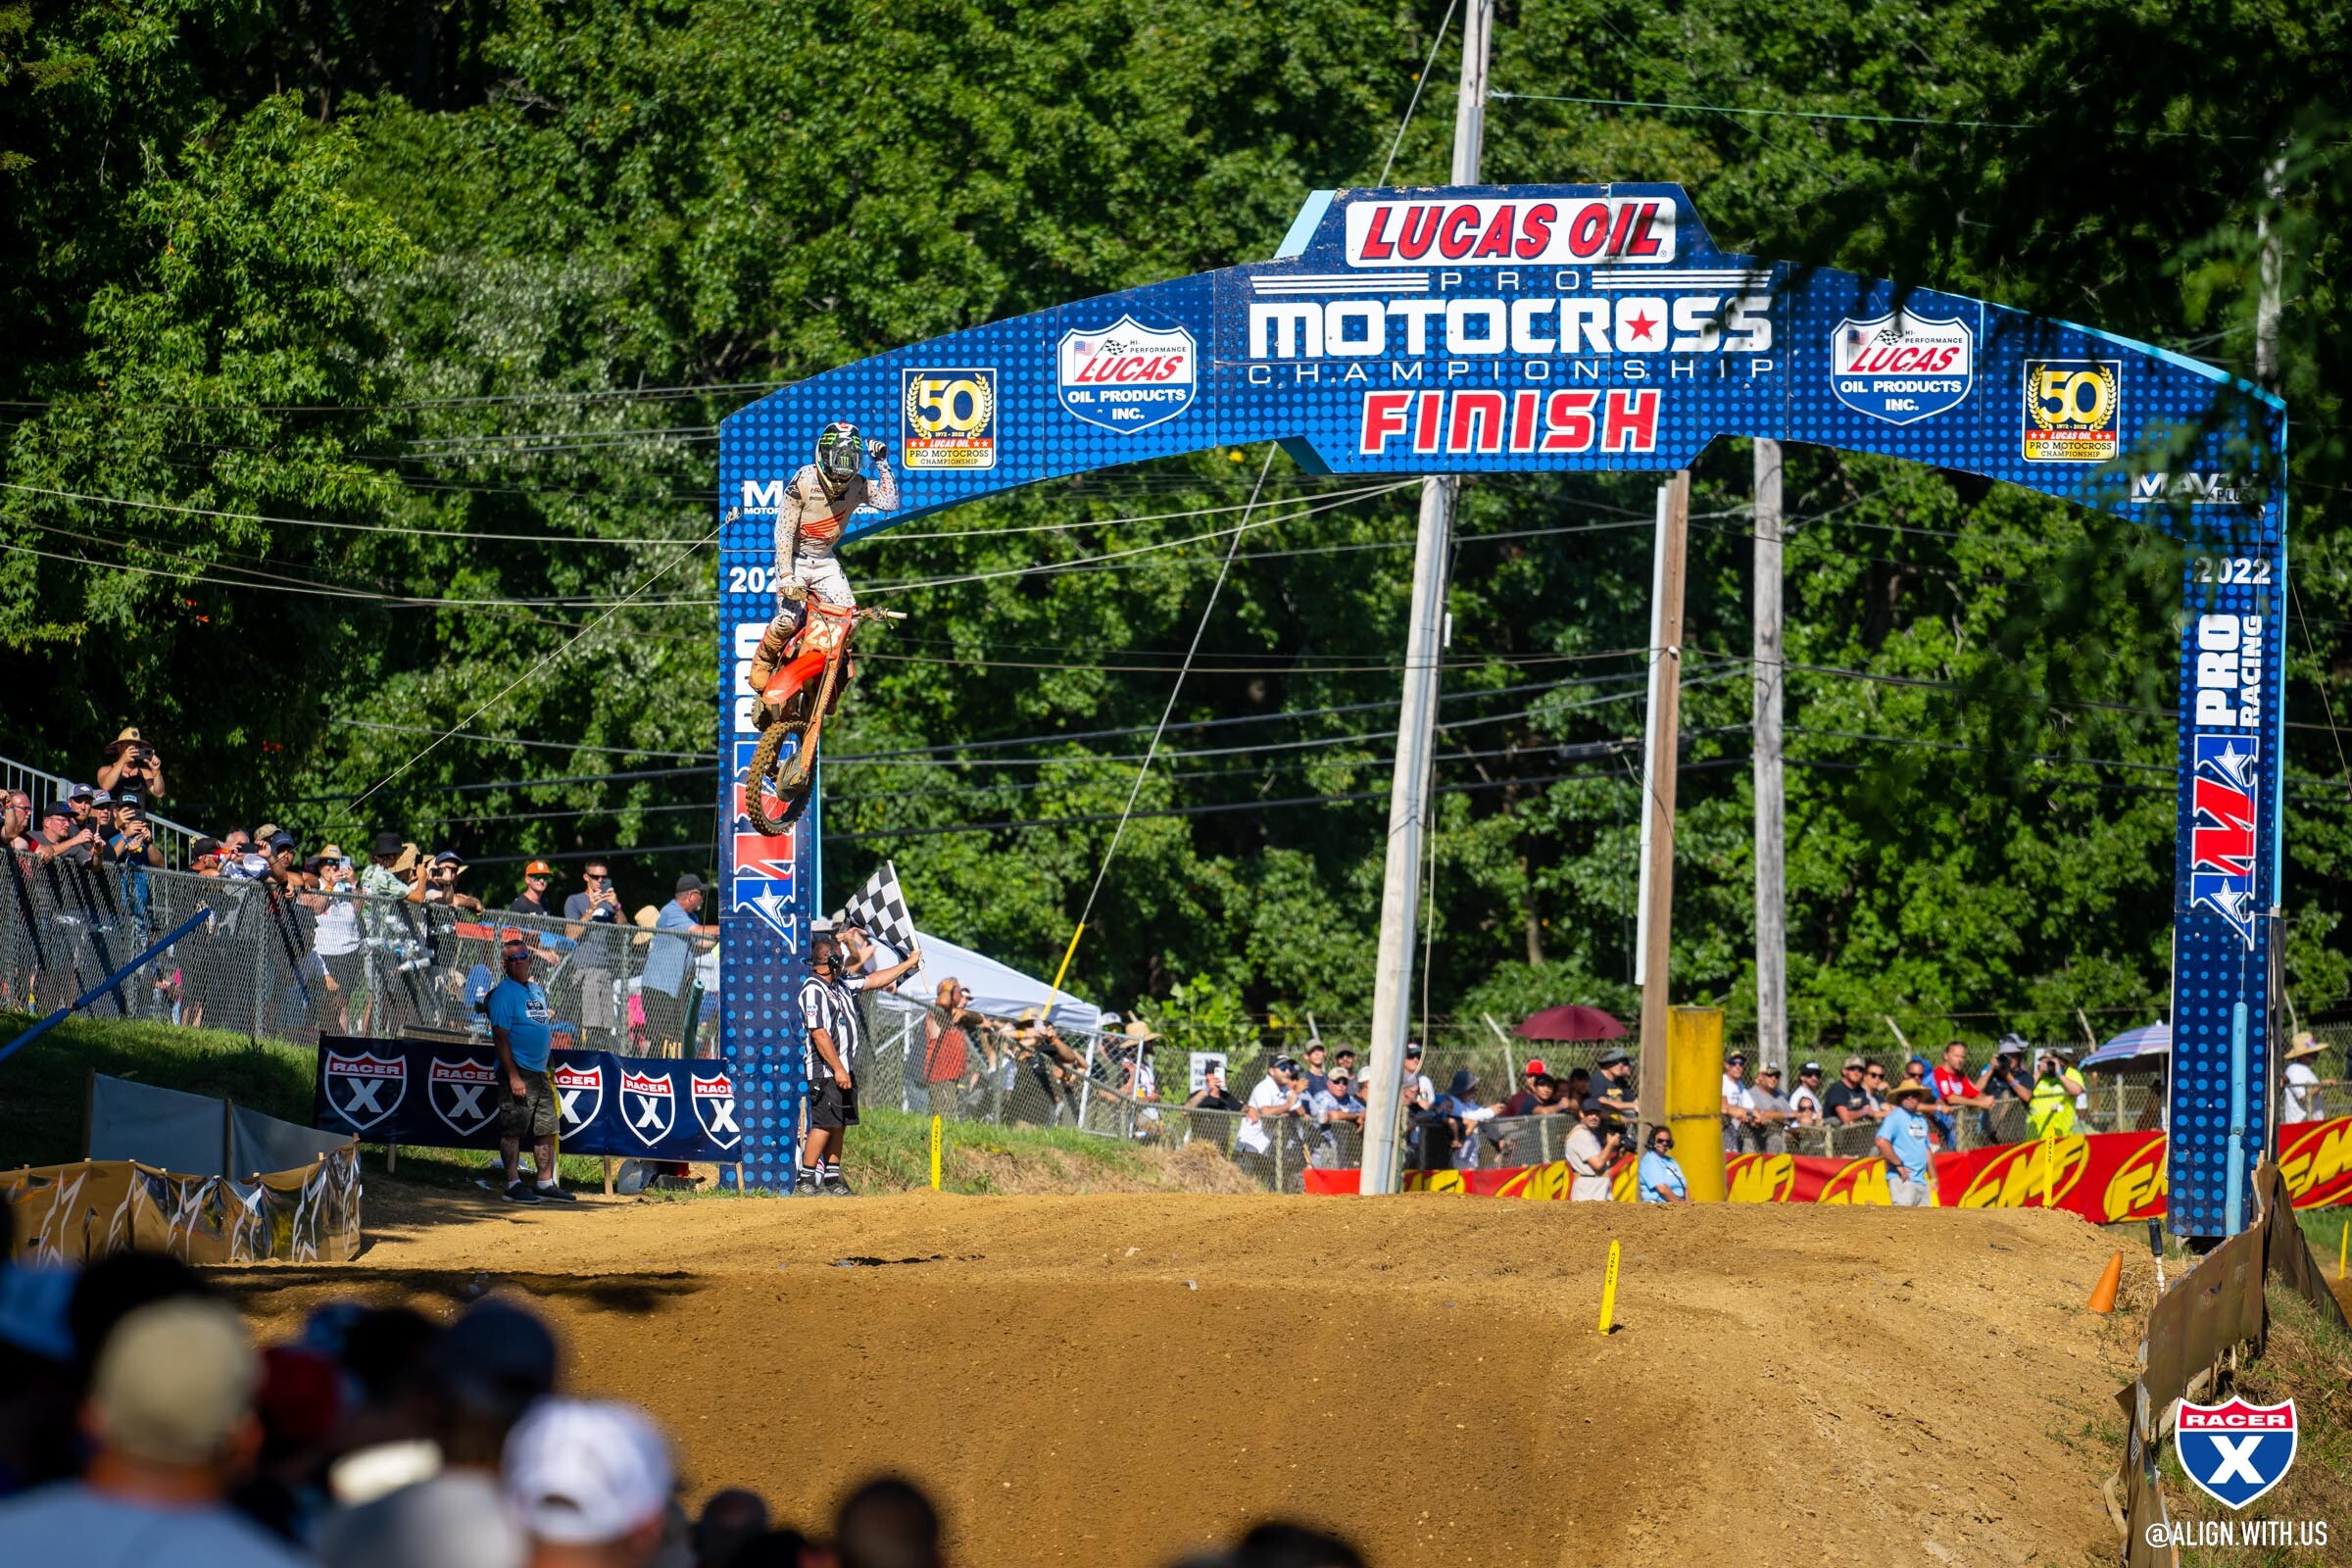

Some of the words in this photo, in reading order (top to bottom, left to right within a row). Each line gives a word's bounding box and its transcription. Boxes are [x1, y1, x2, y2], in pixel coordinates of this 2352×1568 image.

[1360, 204, 1557, 261] LUCAS
[1568, 202, 1663, 257] OIL
[1441, 271, 1580, 291] PRO
[1250, 297, 1773, 359] MOTOCROSS
[1074, 356, 1184, 383] LUCAS
[1249, 360, 1774, 385] CHAMPIONSHIP
[1848, 347, 1960, 372] LUCAS
[1068, 391, 1097, 404] OIL
[1101, 389, 1186, 404] PRODUCTS
[1840, 380, 1868, 393] OIL
[1874, 380, 1962, 393] PRODUCTS
[2037, 370, 2109, 424] 50
[917, 379, 985, 432] 50
[1112, 408, 1145, 420] INC.
[1886, 399, 1919, 412] INC.
[1359, 389, 1661, 456] FINISH
[929, 439, 956, 448] LUCAS
[956, 439, 970, 448] OIL
[729, 567, 777, 593] 202
[2193, 557, 2271, 585] 2022
[807, 619, 843, 648] 23
[2195, 614, 2240, 726] PRO
[2239, 615, 2263, 727] RACING
[332, 1062, 400, 1075] RACER
[554, 1076, 597, 1085] CER
[344, 1078, 384, 1113] X
[626, 1080, 668, 1093] RACER
[448, 1084, 486, 1119] X
[559, 1091, 581, 1124] X
[635, 1095, 665, 1129] X
[710, 1099, 740, 1133] X
